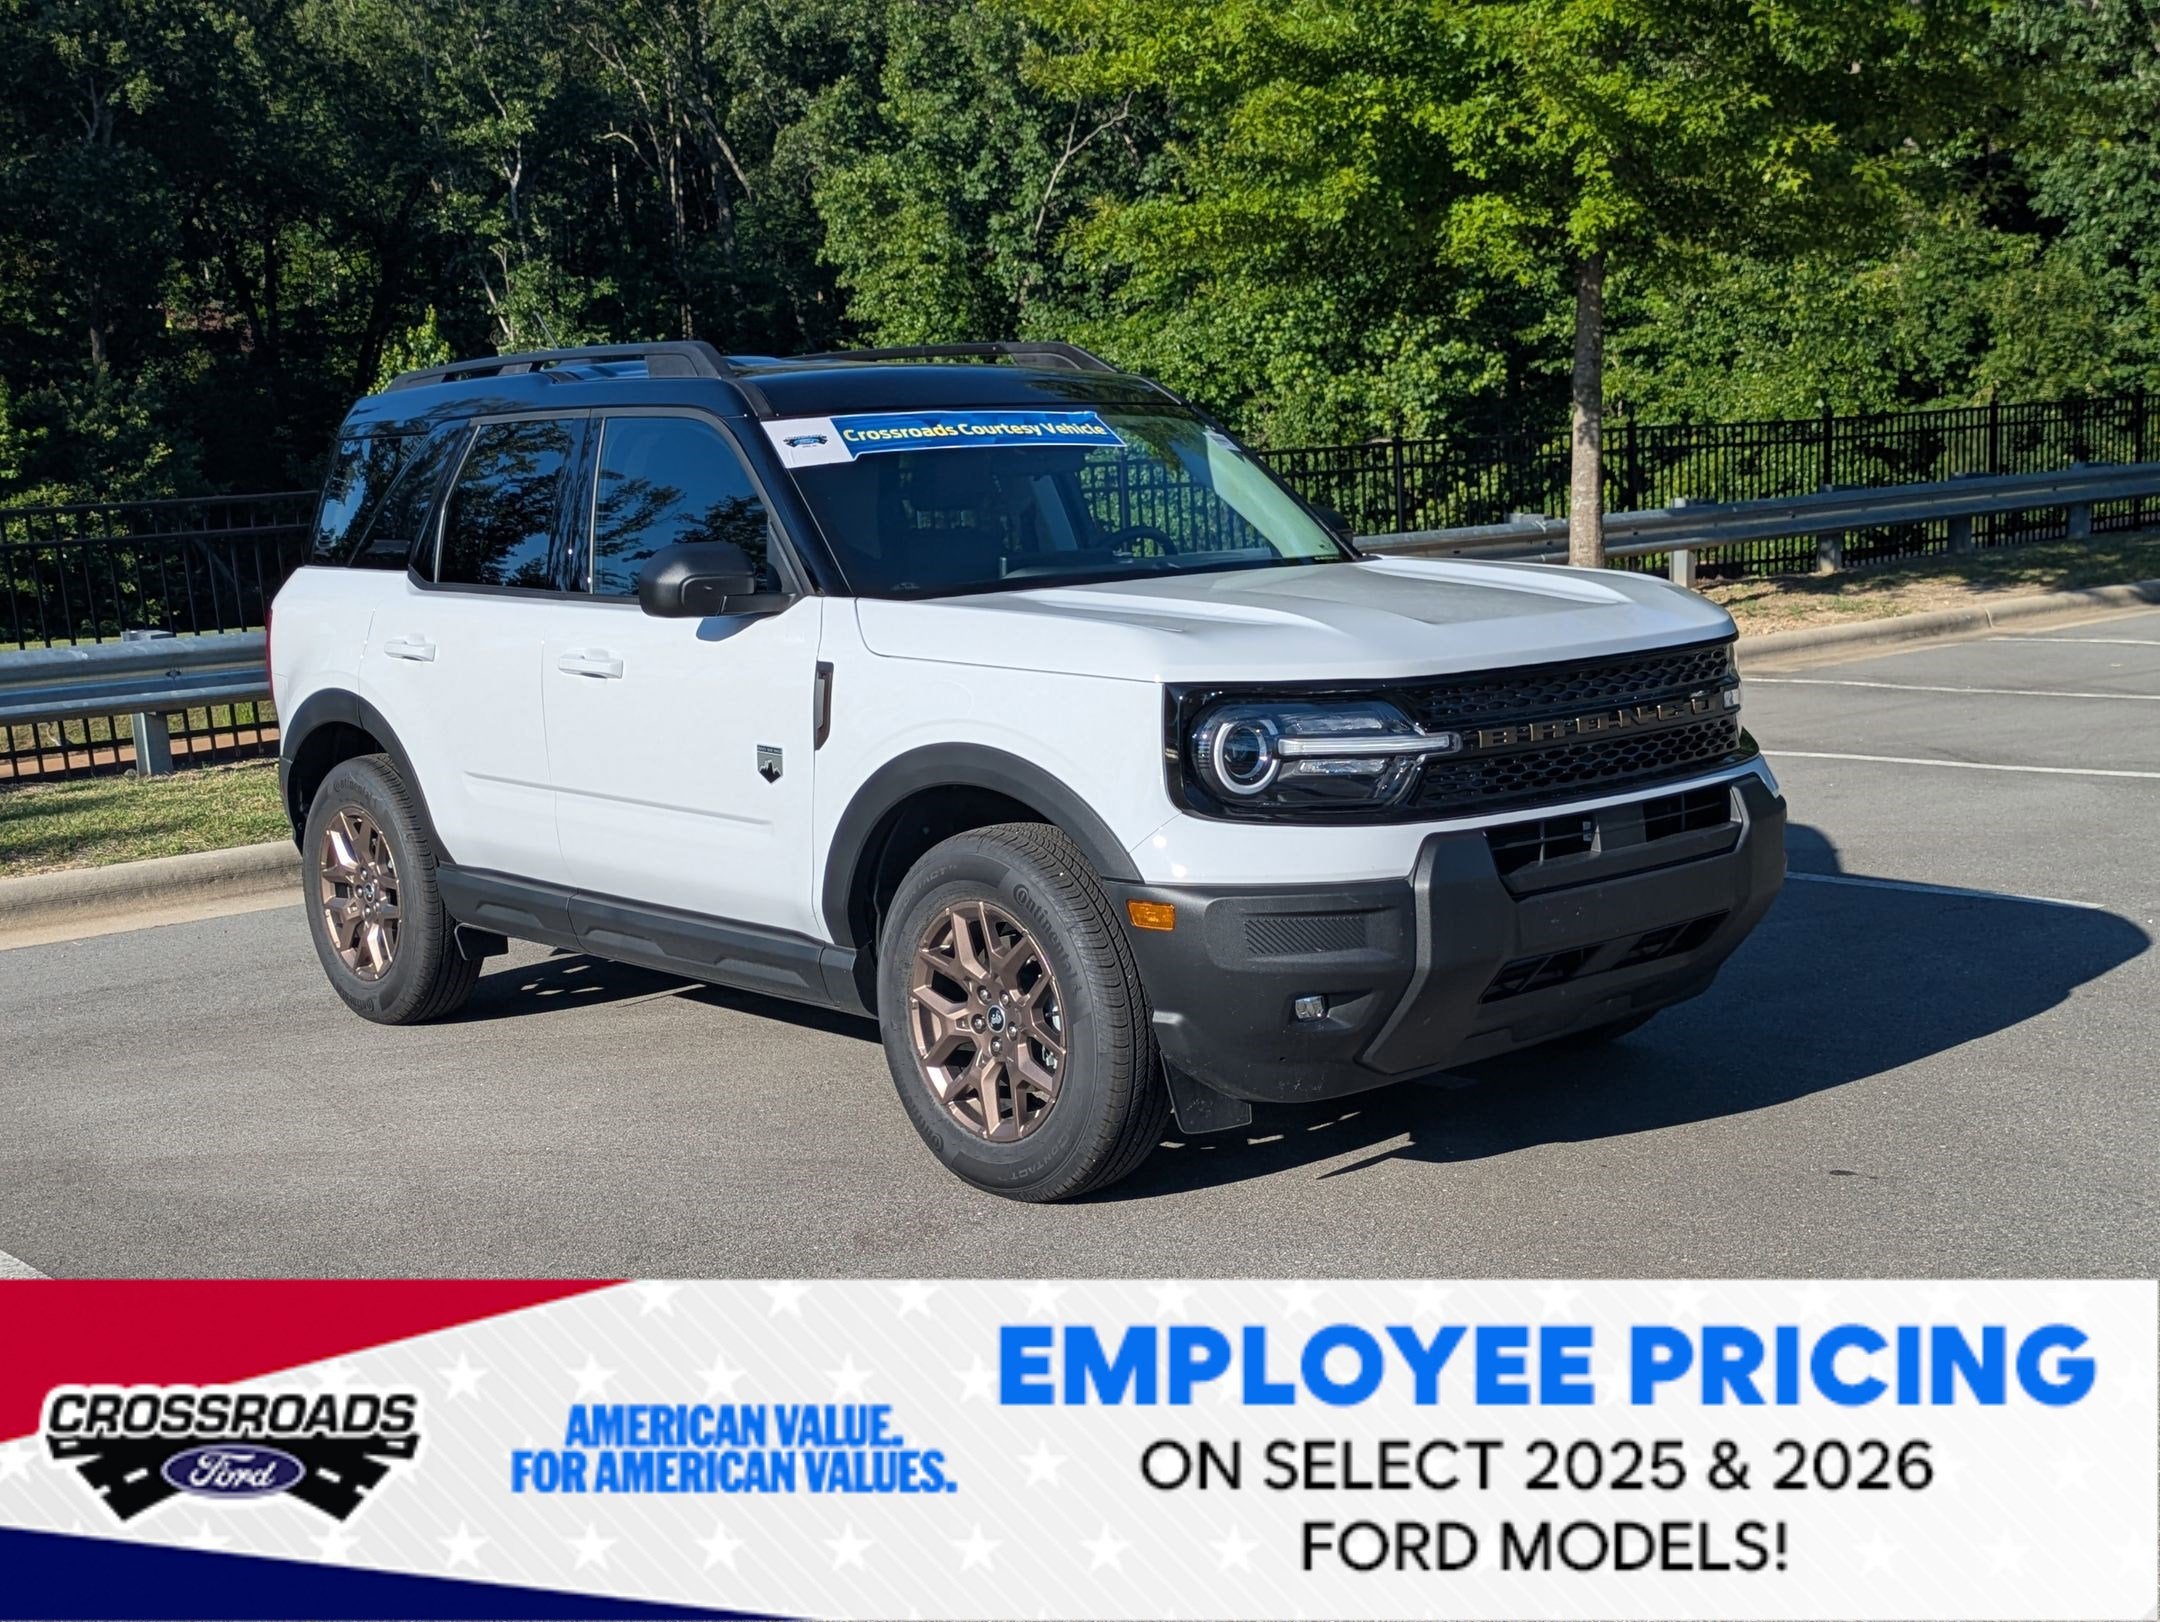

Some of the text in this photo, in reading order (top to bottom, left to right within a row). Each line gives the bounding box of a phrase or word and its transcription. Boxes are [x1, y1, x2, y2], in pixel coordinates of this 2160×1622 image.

[842, 424, 959, 441] Crossroads
[957, 423, 1042, 436] Courtesy
[1040, 422, 1107, 435] Vehicle
